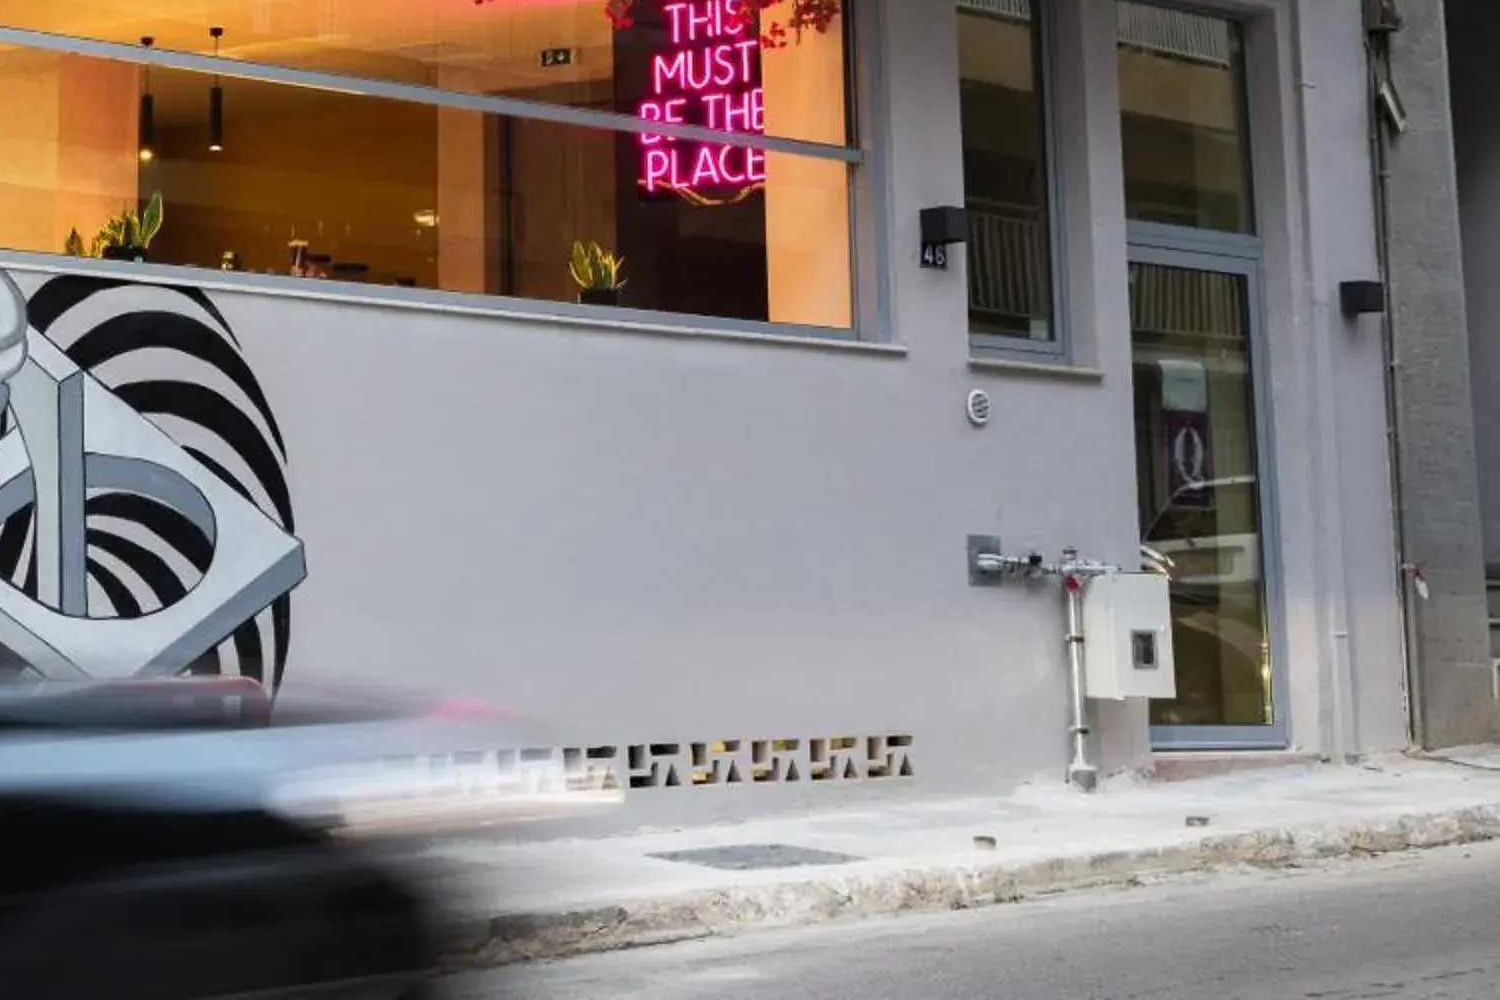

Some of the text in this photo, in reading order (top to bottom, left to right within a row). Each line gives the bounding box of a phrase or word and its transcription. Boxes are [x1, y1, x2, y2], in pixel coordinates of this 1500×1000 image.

[654, 41, 757, 94] MUST
[701, 88, 765, 131] THE
[647, 145, 767, 191] PLACE
